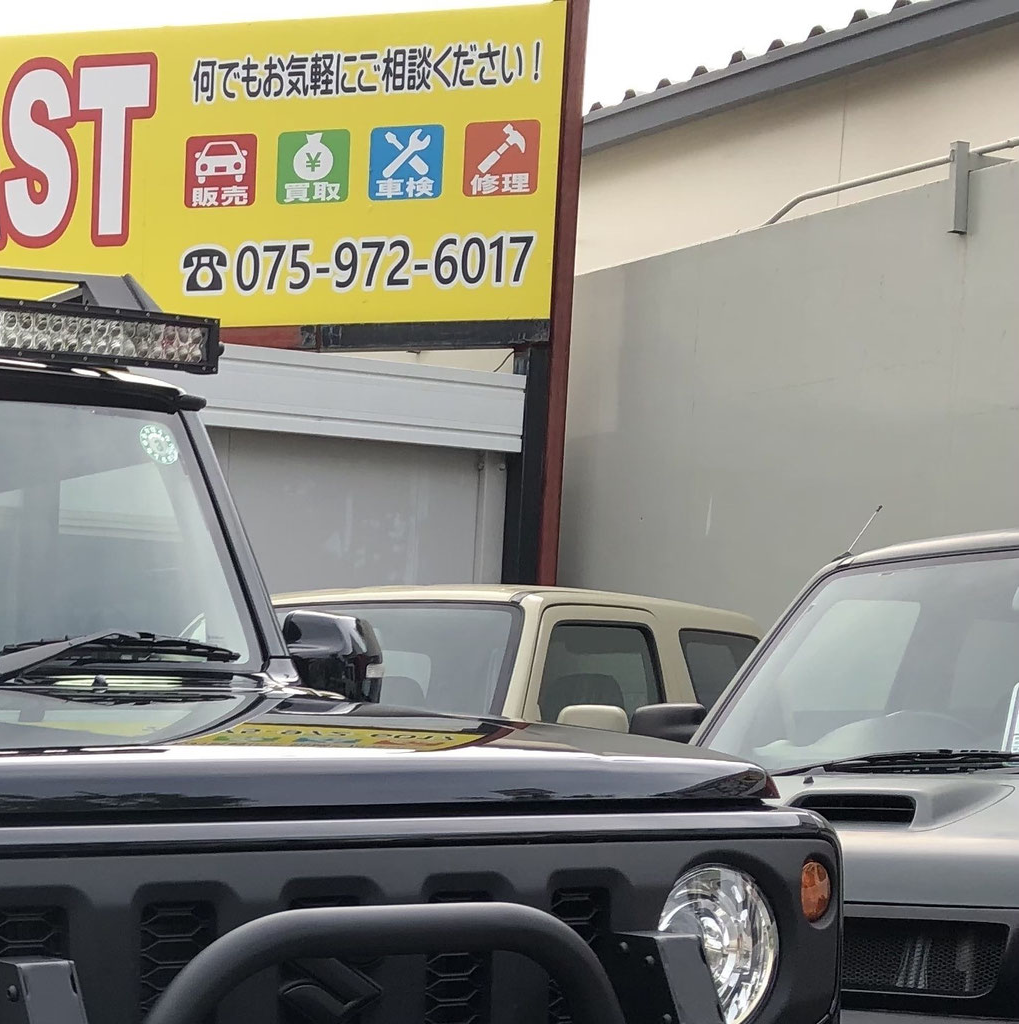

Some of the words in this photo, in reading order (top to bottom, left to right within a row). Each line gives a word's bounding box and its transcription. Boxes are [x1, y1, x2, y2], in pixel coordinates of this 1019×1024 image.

[283, 181, 341, 203] 買取
[375, 177, 435, 198] 車検
[470, 173, 530, 194] 修理
[191, 186, 249, 206] 販売
[236, 236, 534, 291] 075-972-6017
